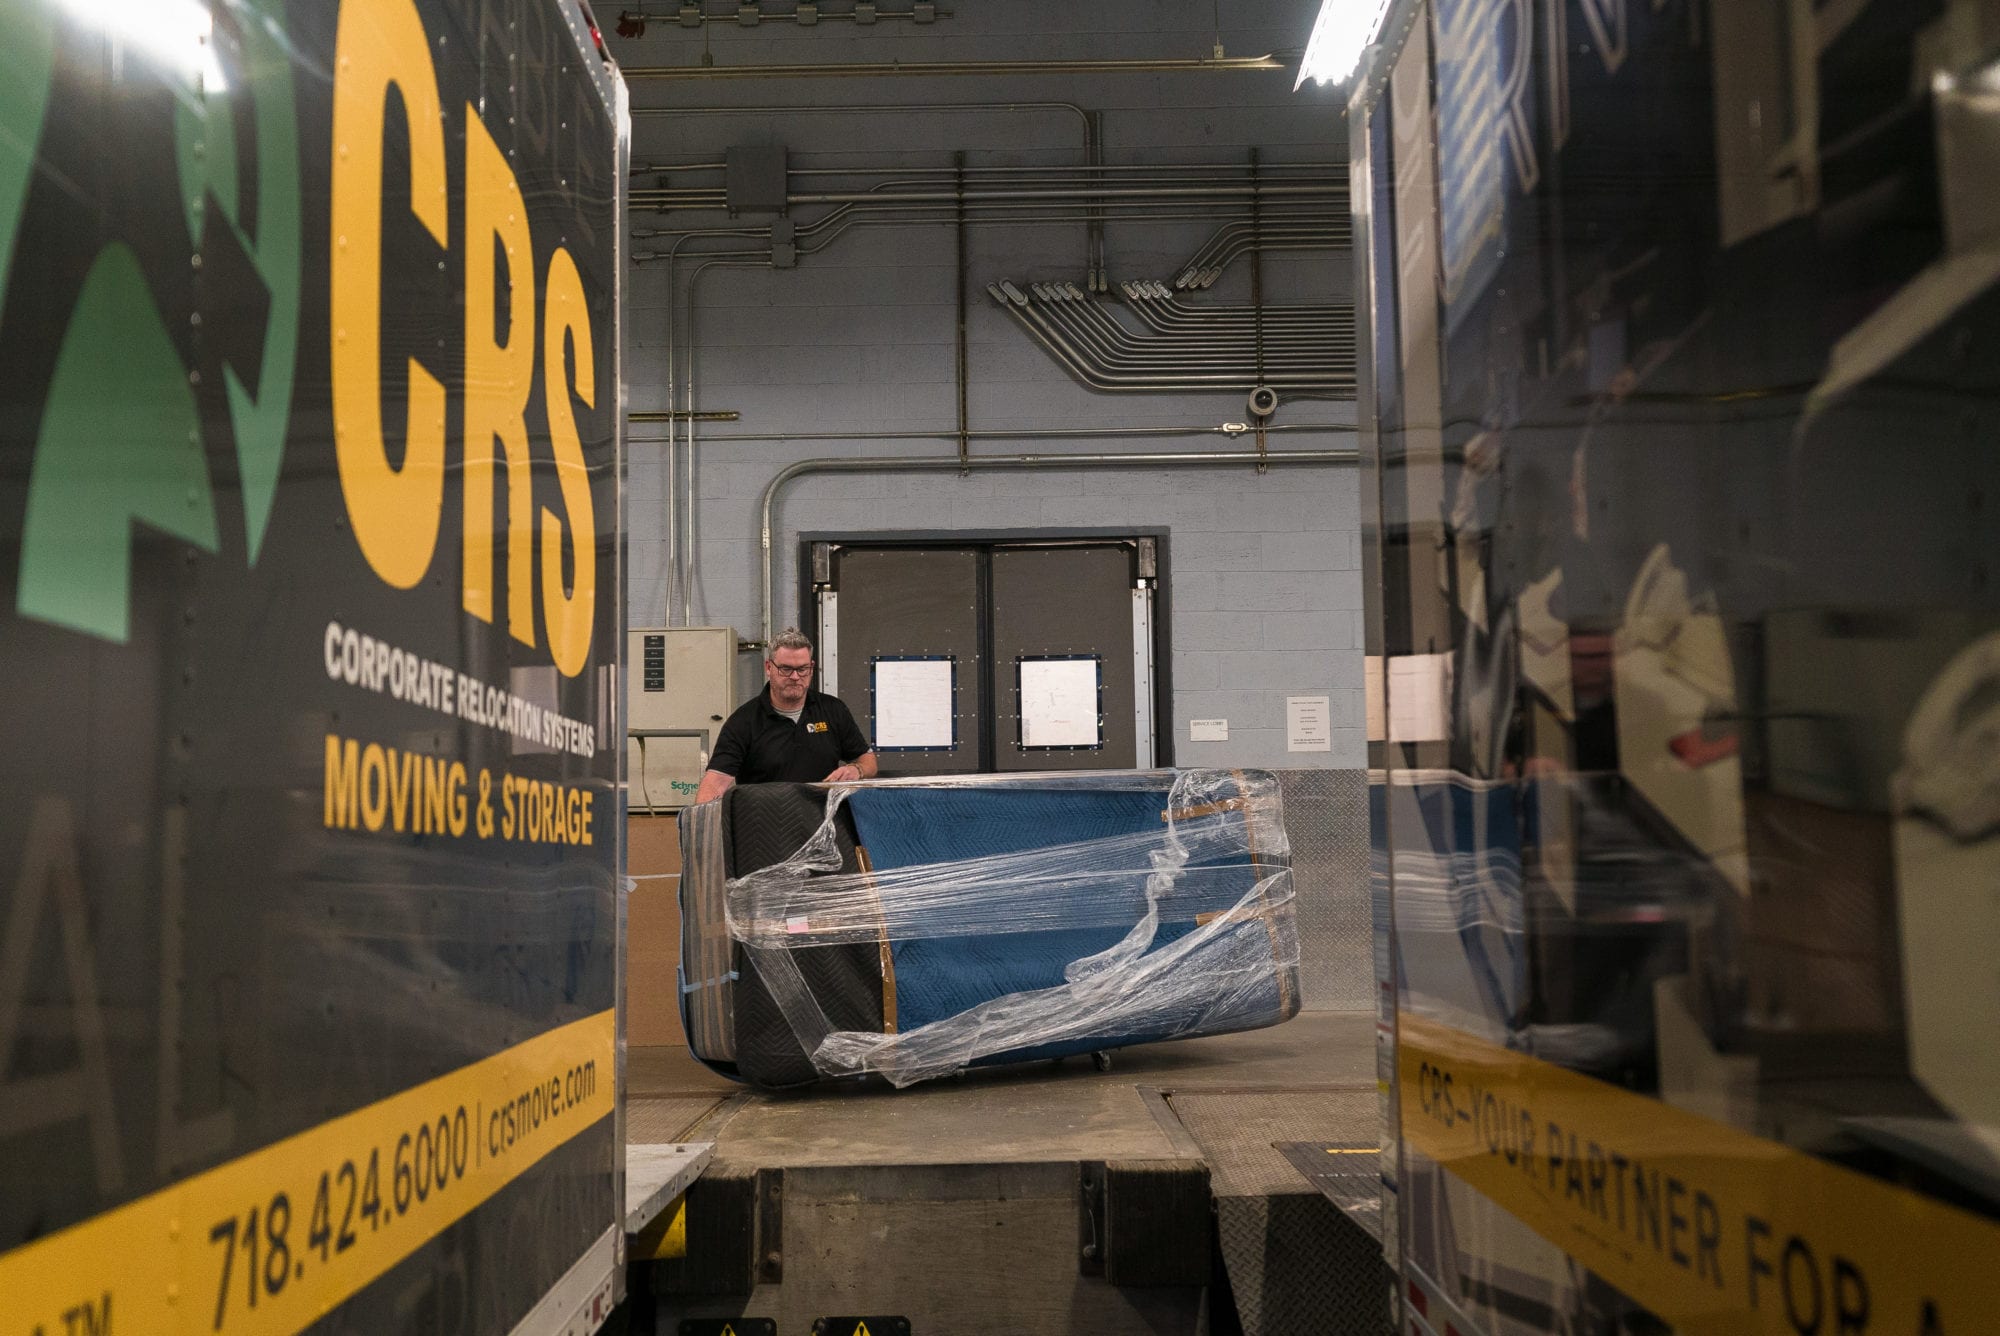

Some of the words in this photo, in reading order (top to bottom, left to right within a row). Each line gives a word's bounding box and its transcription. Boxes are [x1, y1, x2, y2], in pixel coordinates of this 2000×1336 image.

[331, 0, 595, 677] CRS
[324, 620, 454, 714] CORPORATE
[457, 672, 541, 743] RELOCATION
[542, 709, 594, 758] SYSTEMS
[324, 734, 467, 837] MOVING
[476, 768, 494, 838] &
[502, 772, 592, 845] STORAGE
[209, 1105, 469, 1332] 718.424.6000
[489, 1058, 596, 1158] crsmove.com
[1549, 1122, 1724, 1288] PARTNER
[1746, 1217, 1870, 1336] FOR
